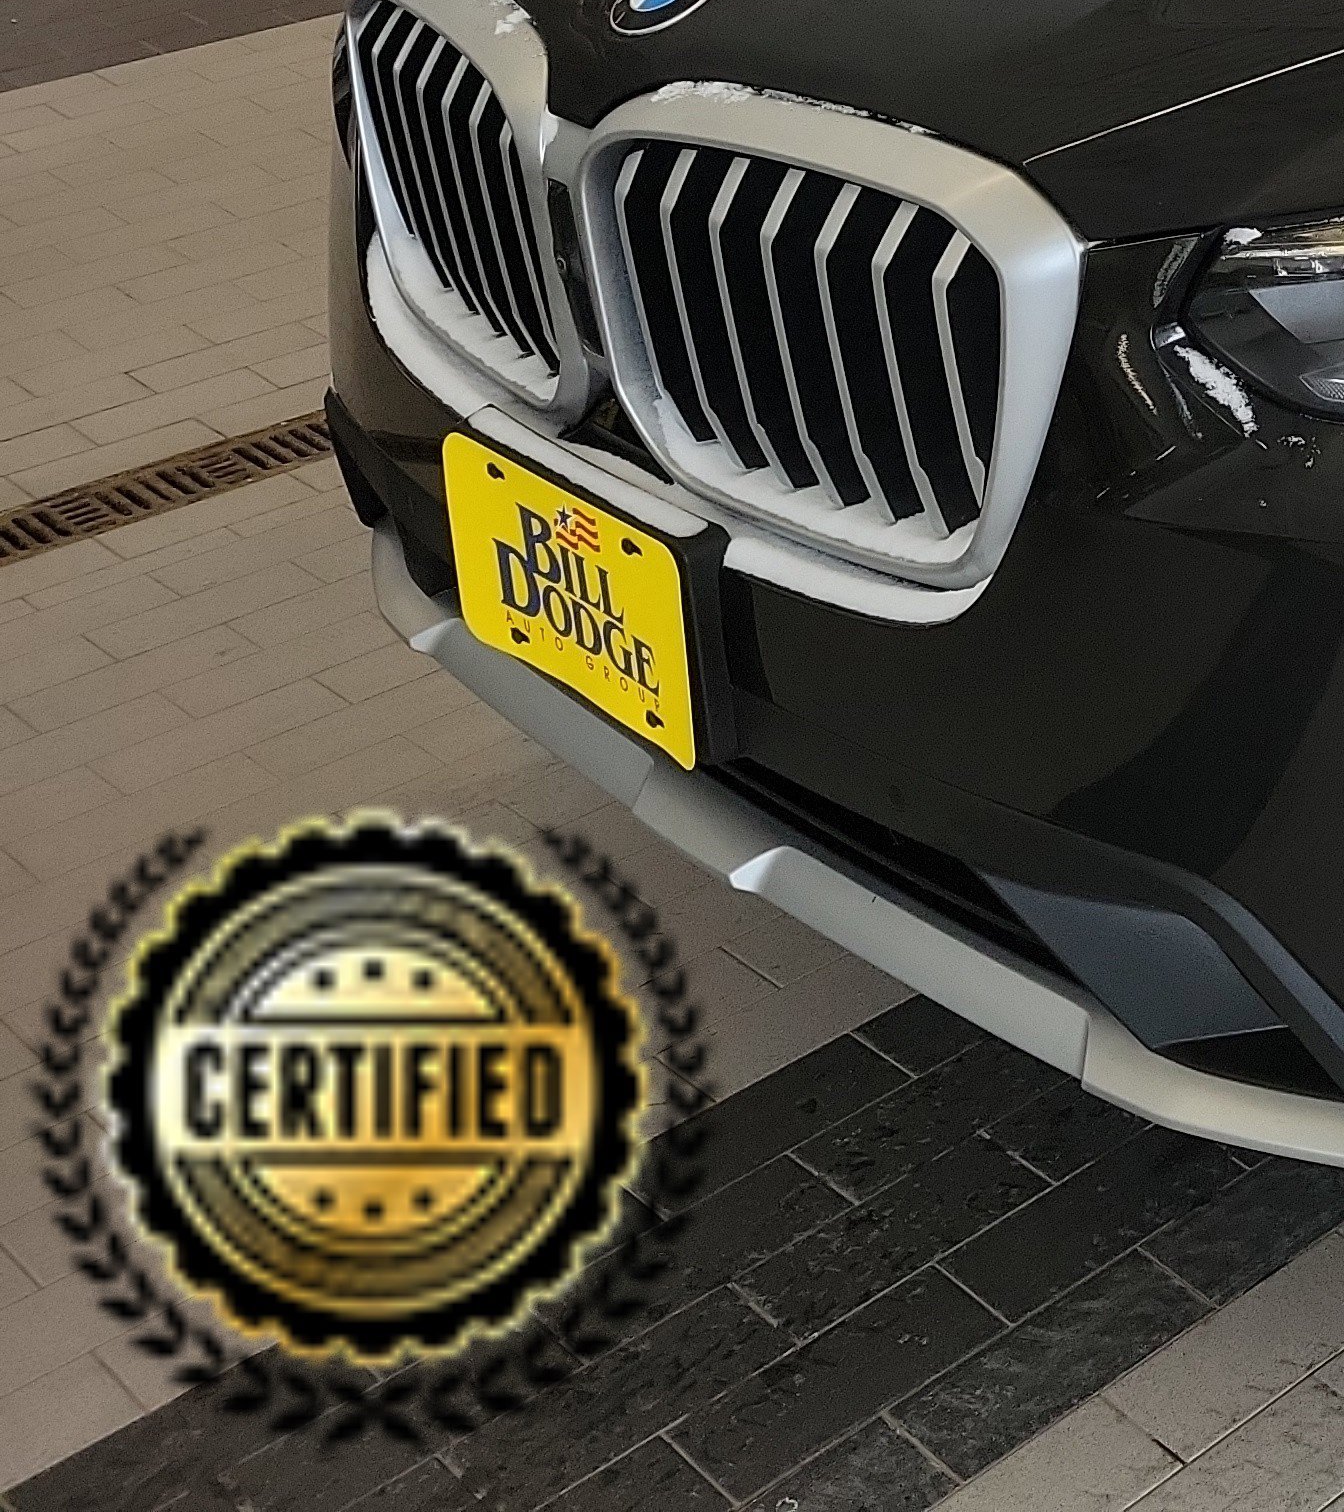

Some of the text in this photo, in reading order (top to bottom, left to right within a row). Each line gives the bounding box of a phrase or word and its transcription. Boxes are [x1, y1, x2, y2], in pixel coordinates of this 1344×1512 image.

[493, 538, 660, 698] DODGE
[516, 501, 625, 627] BILL
[505, 609, 660, 711] AUTO GROUP
